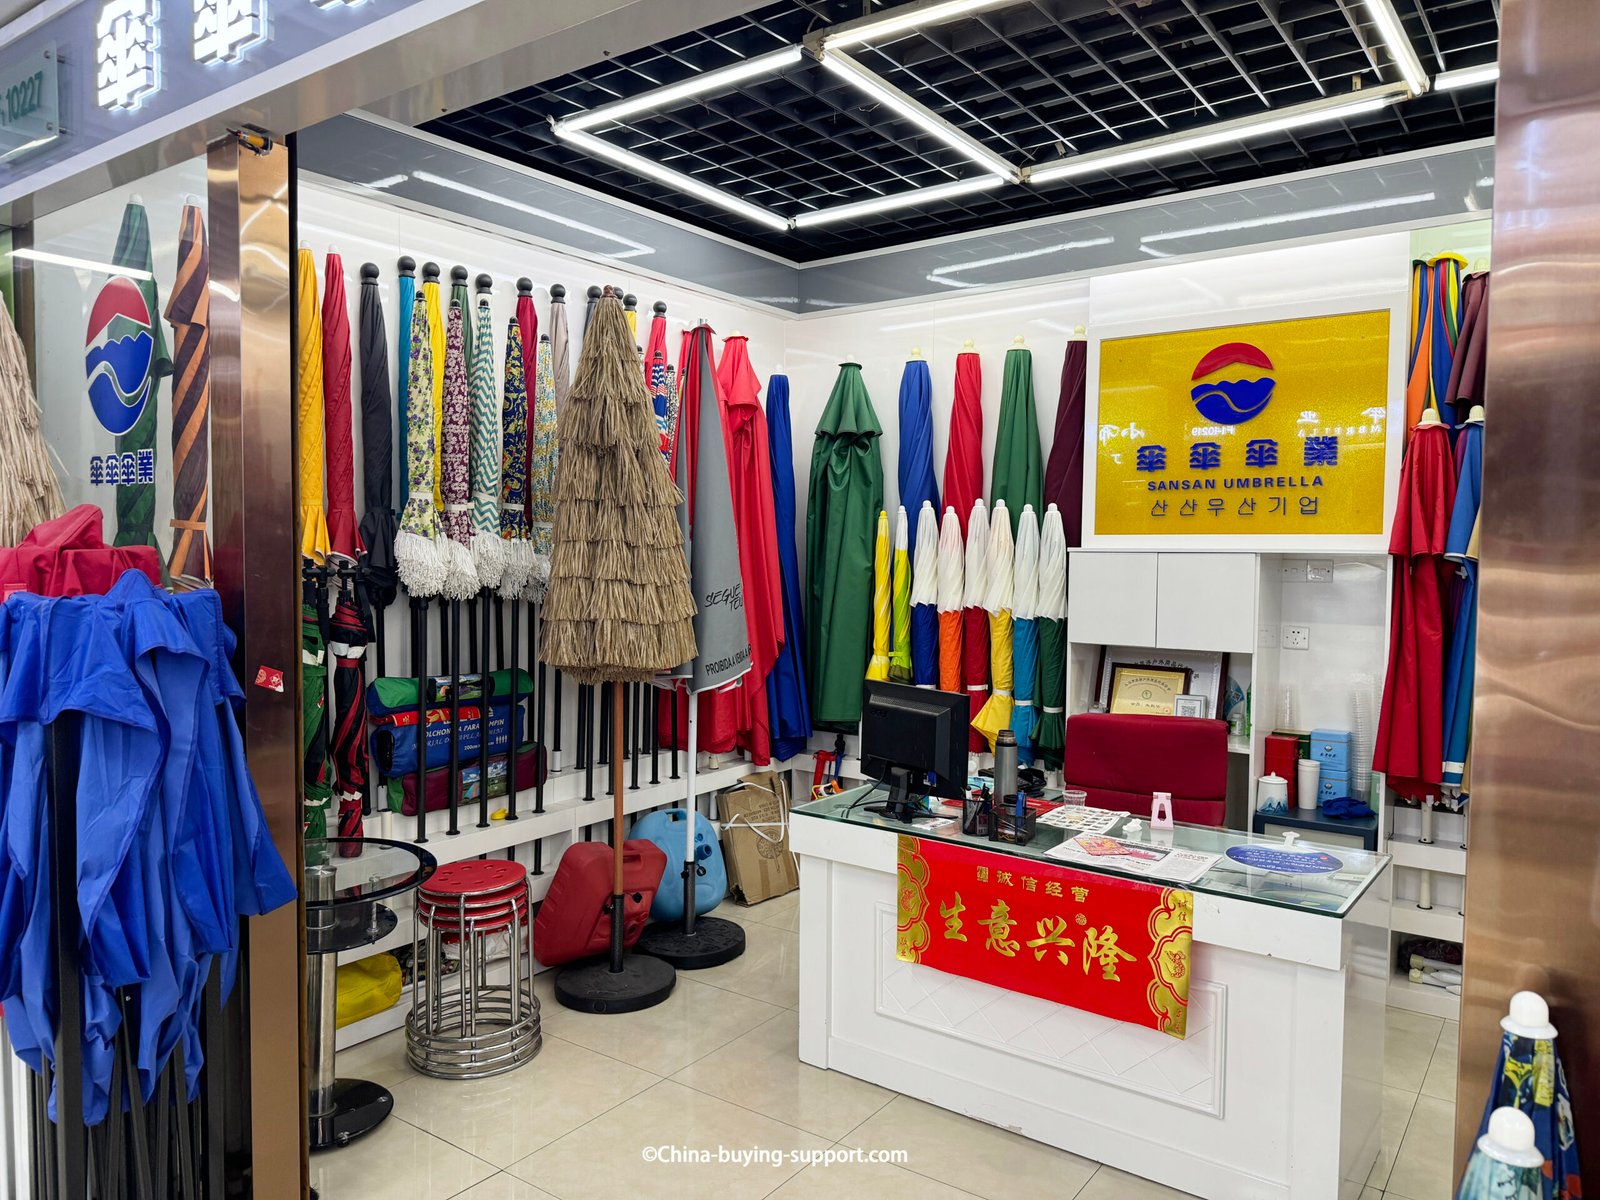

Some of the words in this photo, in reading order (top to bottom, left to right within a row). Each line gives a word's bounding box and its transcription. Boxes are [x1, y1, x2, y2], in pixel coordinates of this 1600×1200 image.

[1147, 479, 1217, 492] SANSAN
[1223, 475, 1324, 490] UMBRELLA
[1150, 496, 1320, 518] 산산우산기업
[704, 583, 741, 607] SEGUE
[996, 869, 1089, 903] 诚信经营
[939, 890, 1137, 983] 生意兴隆
